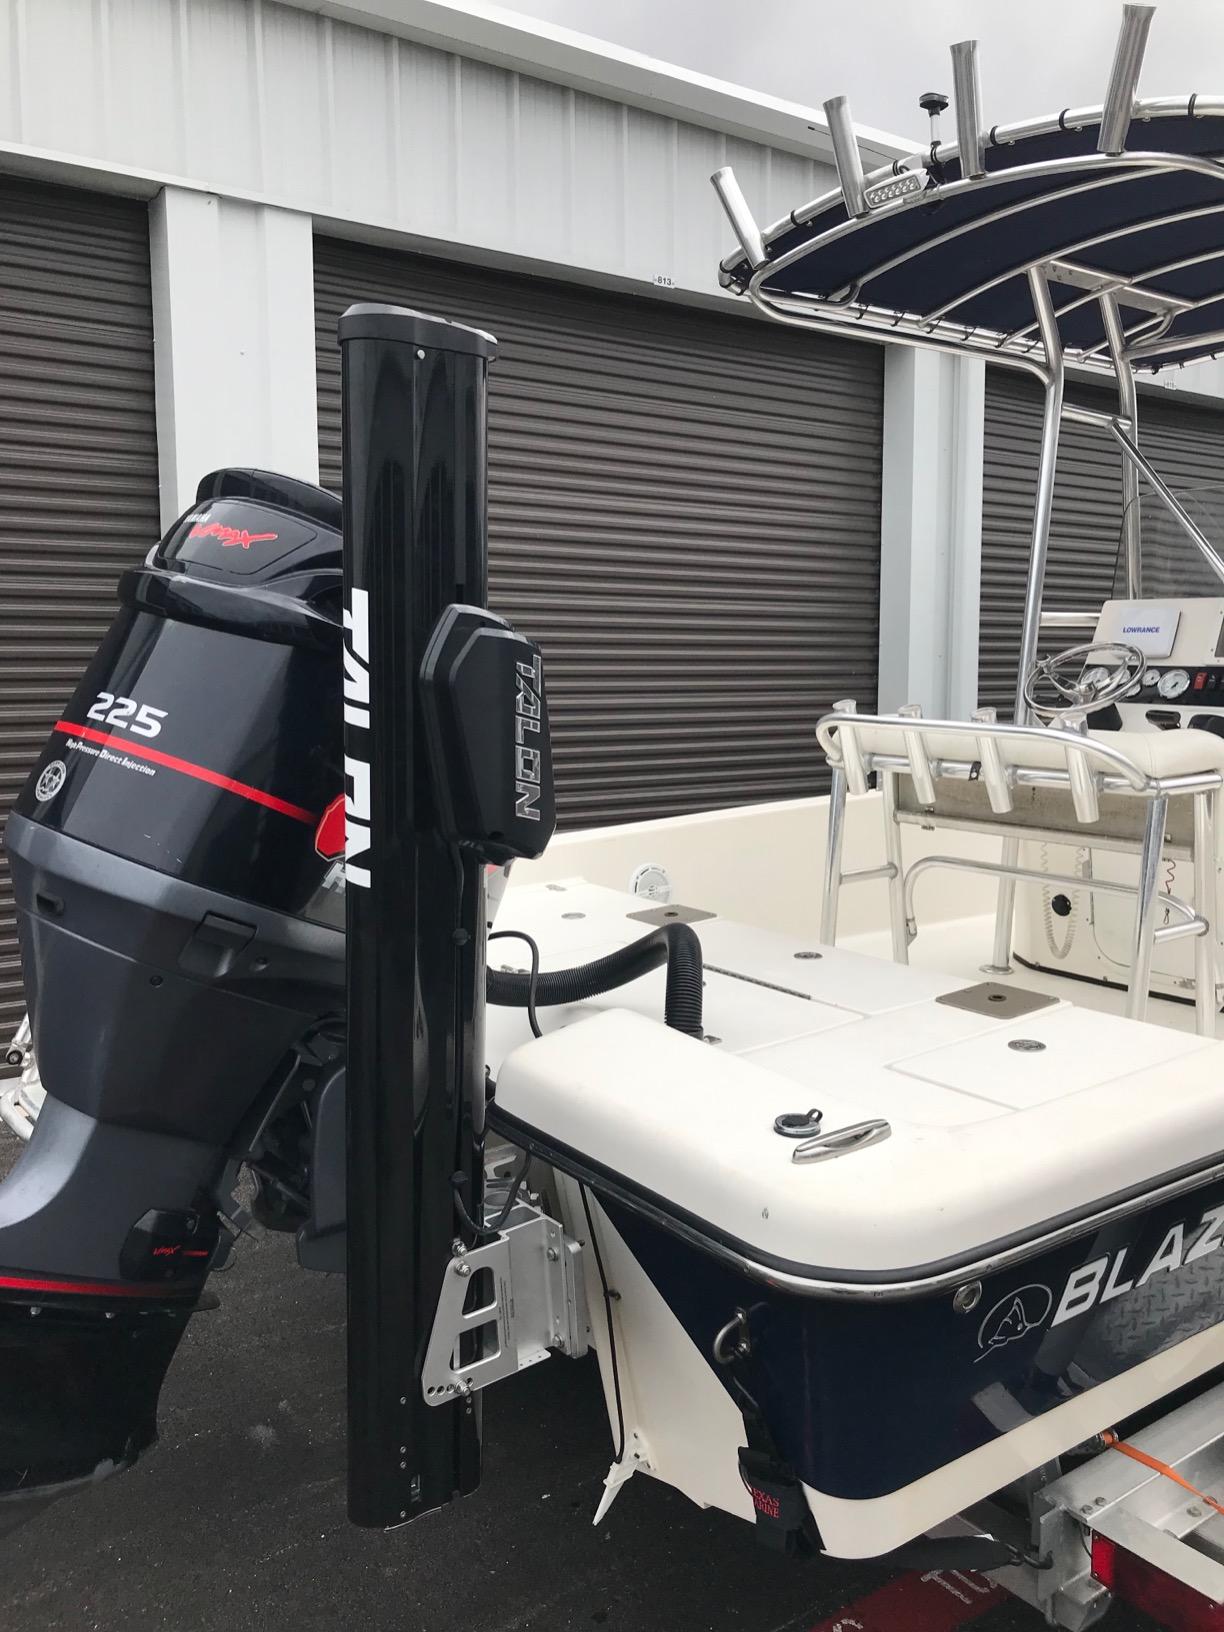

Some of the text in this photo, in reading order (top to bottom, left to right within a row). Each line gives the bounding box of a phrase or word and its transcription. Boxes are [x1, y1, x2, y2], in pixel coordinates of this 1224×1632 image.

[1122, 626, 1161, 634] LOWRANCE
[86, 691, 169, 739] 225
[515, 654, 542, 822] TALON
[99, 748, 123, 765] Direct
[121, 756, 156, 777] Injection
[1051, 1203, 1224, 1328] BLAZ
[752, 1487, 780, 1507] EXAS
